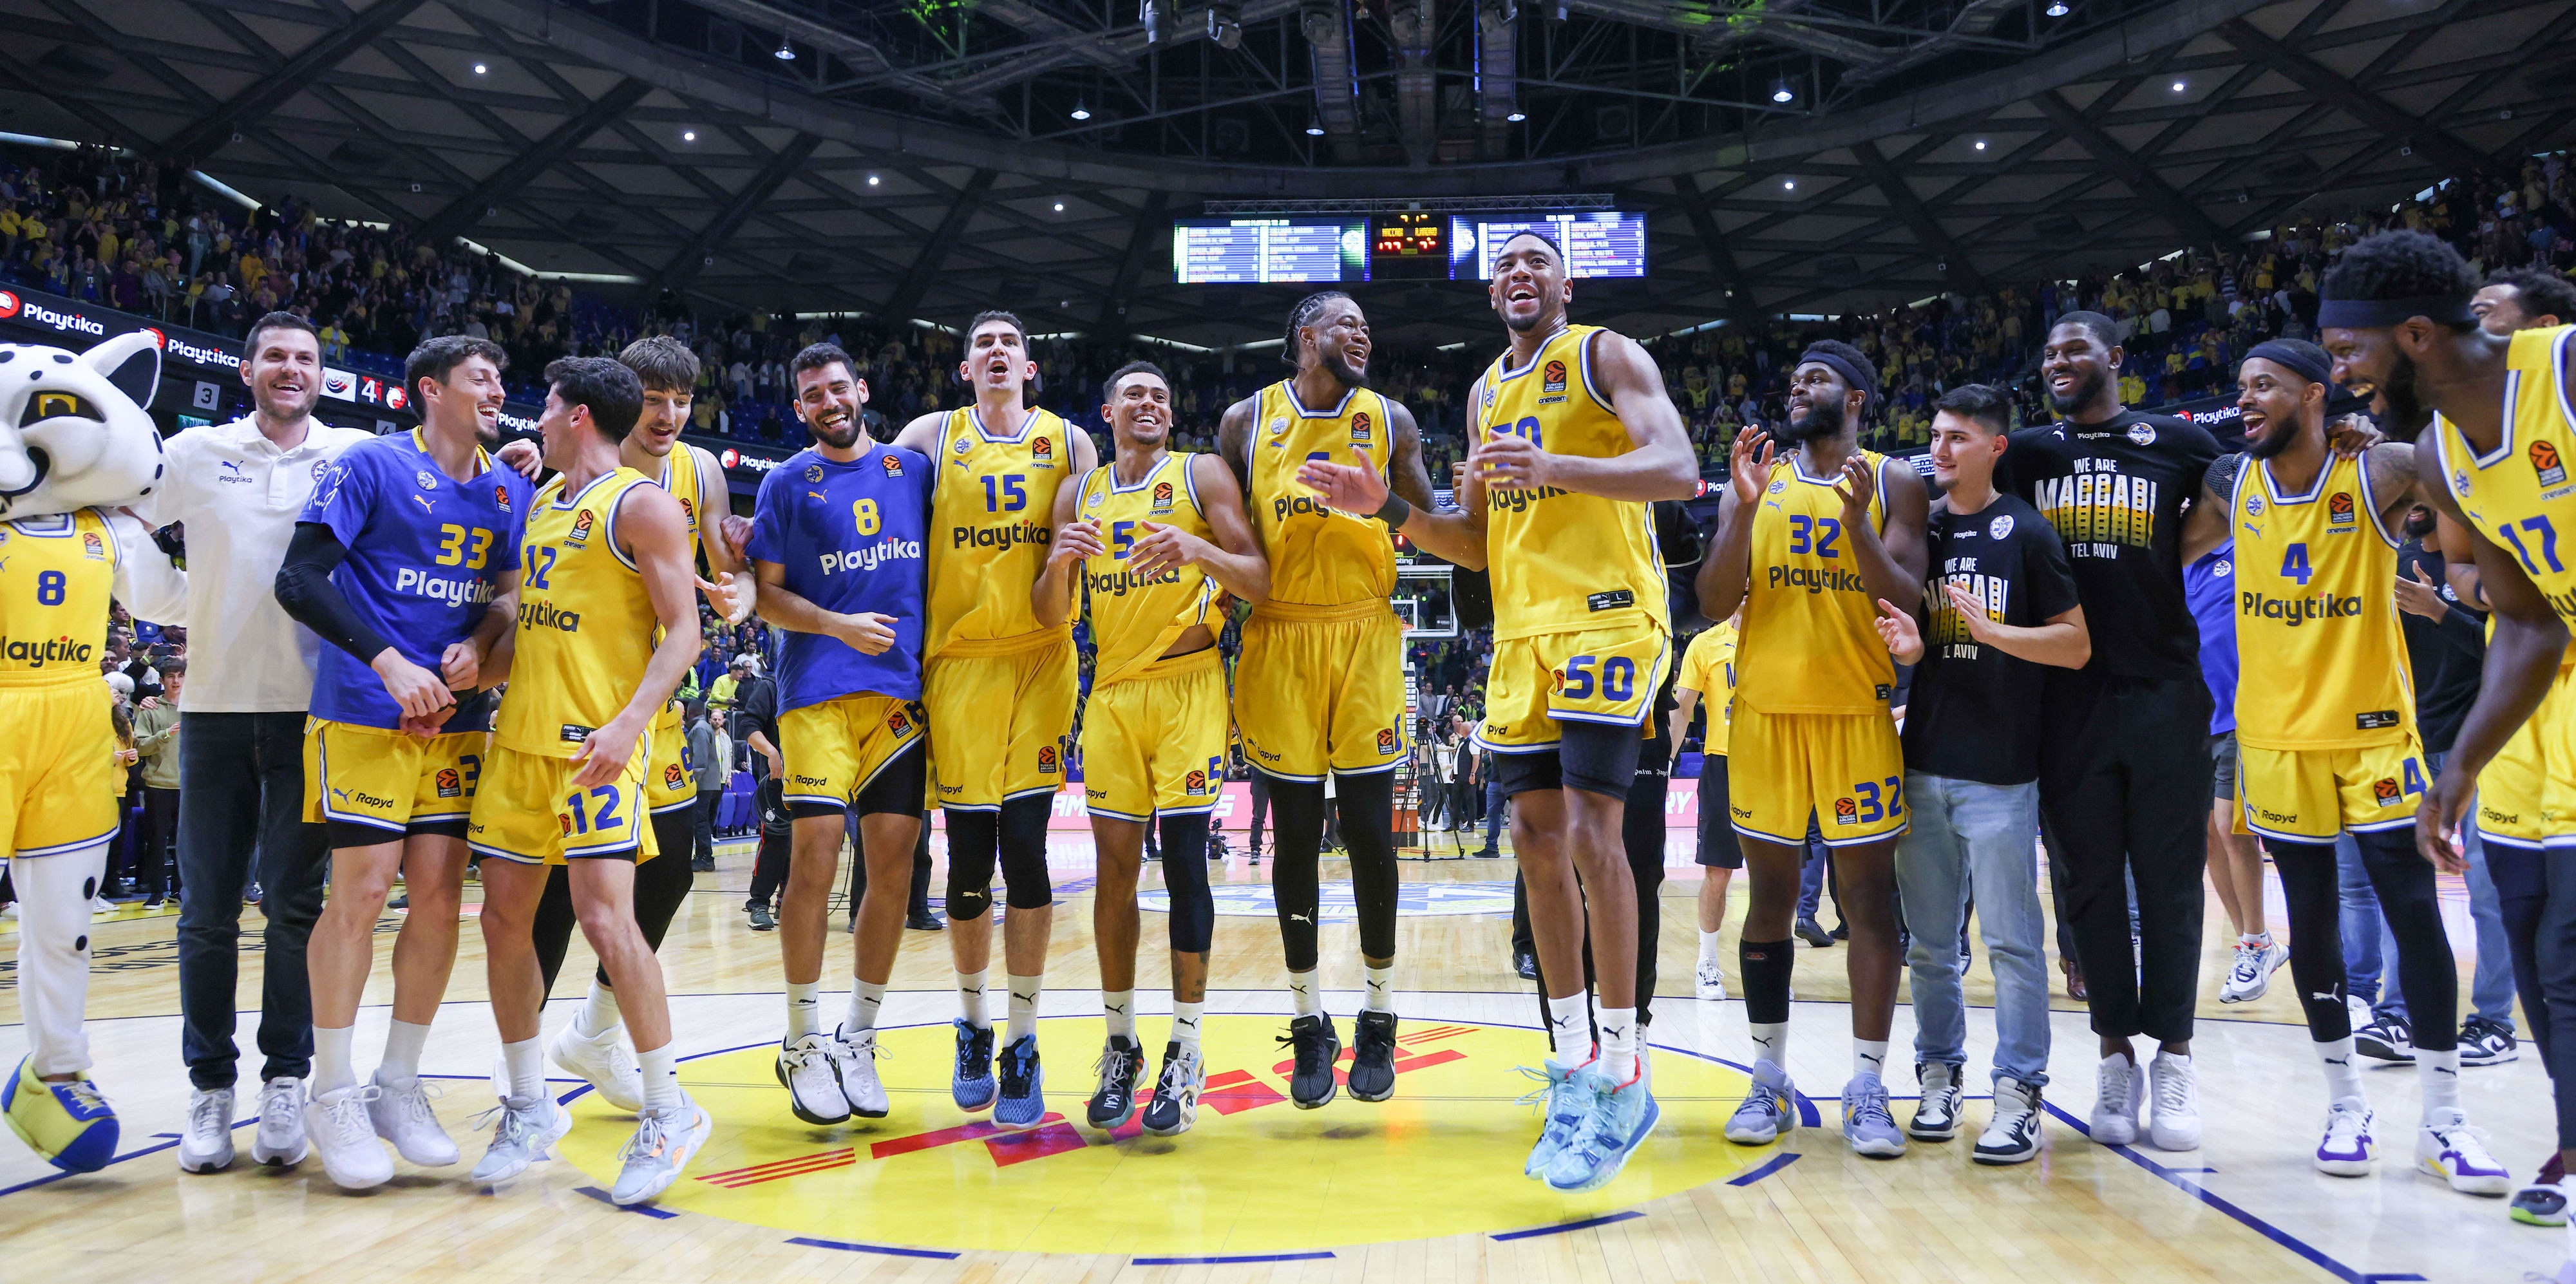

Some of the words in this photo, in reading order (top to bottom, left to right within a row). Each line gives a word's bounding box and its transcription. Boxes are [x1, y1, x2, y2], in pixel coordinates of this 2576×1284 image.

[24, 303, 104, 335] Playtika
[167, 339, 240, 368] Playtika
[201, 388, 213, 404] 3
[1539, 395, 1567, 404] oneteam
[498, 411, 538, 432] Playtik
[2193, 406, 2240, 424] Playtika
[219, 475, 252, 484] Playtika
[2074, 457, 2091, 474] WE
[2095, 458, 2117, 473] ARE
[981, 475, 1027, 512] 15
[1707, 481, 1728, 493] Play
[2035, 473, 2157, 516] MACCABI
[853, 498, 881, 536] 8
[435, 524, 494, 570] 33
[564, 540, 588, 551] oneteam
[954, 520, 1050, 551] Playtika
[1113, 521, 1135, 560] 5
[1790, 515, 1841, 558] 32
[1954, 530, 1978, 540] Playtika
[2499, 514, 2565, 575] 17
[525, 545, 556, 590] 12
[819, 536, 921, 576] Playtika
[1945, 558, 1958, 574] WE
[1959, 557, 1978, 572] ARE
[2071, 543, 2090, 558] TEL
[2093, 543, 2118, 560] AVIV
[2280, 543, 2313, 585] 4
[38, 570, 66, 606] 8
[518, 599, 580, 632] aytika
[2243, 591, 2362, 627] Playtika
[0, 635, 91, 668] laytika
[1954, 644, 1978, 660] AVIV
[1565, 656, 1634, 702] 50
[1488, 724, 1508, 735] pyd
[459, 753, 486, 797] 3
[795, 775, 828, 787] Rapyd
[940, 784, 963, 795] Rapyd
[1209, 755, 1222, 794] 5
[2402, 757, 2427, 796] 4
[355, 792, 394, 808] Rapyd
[567, 784, 623, 835] 12
[1855, 777, 1902, 824] 32
[2262, 809, 2297, 824] Rapyd
[1104, 1093, 1121, 1109] KAI
